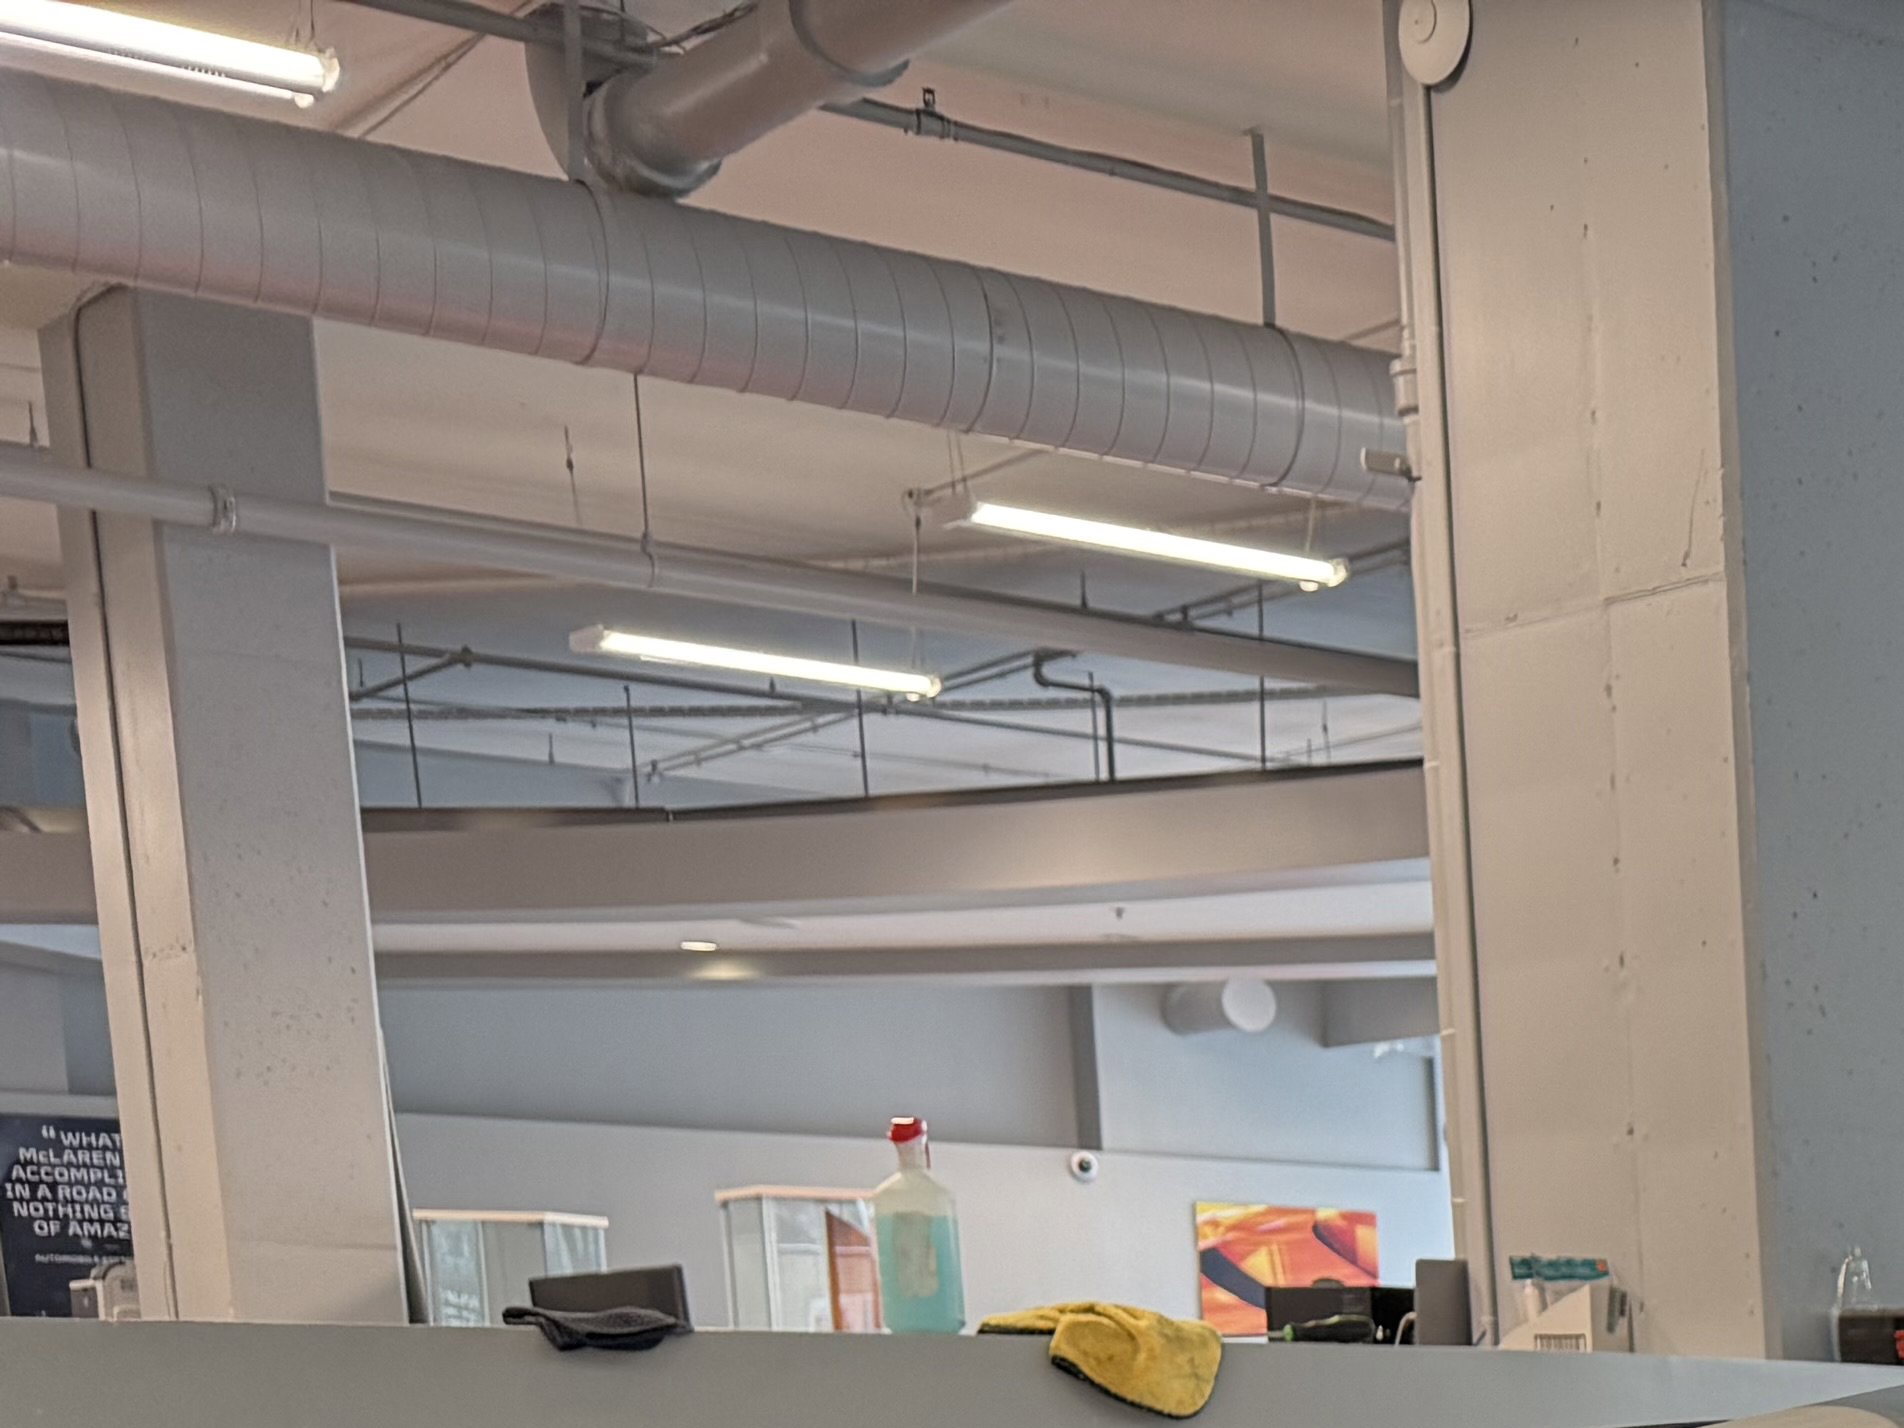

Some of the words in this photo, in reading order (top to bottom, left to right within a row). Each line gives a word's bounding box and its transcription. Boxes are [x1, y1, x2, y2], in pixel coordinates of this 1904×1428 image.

[18, 1147, 121, 1168] McLAREN
[11, 1164, 124, 1185] ACCOMPLI
[5, 1182, 31, 1200] IN
[37, 1184, 52, 1200] A
[57, 1185, 117, 1202] ROAD
[13, 1201, 115, 1220] NOTHING
[33, 1219, 61, 1237] OF
[68, 1221, 131, 1239] AMAZ
